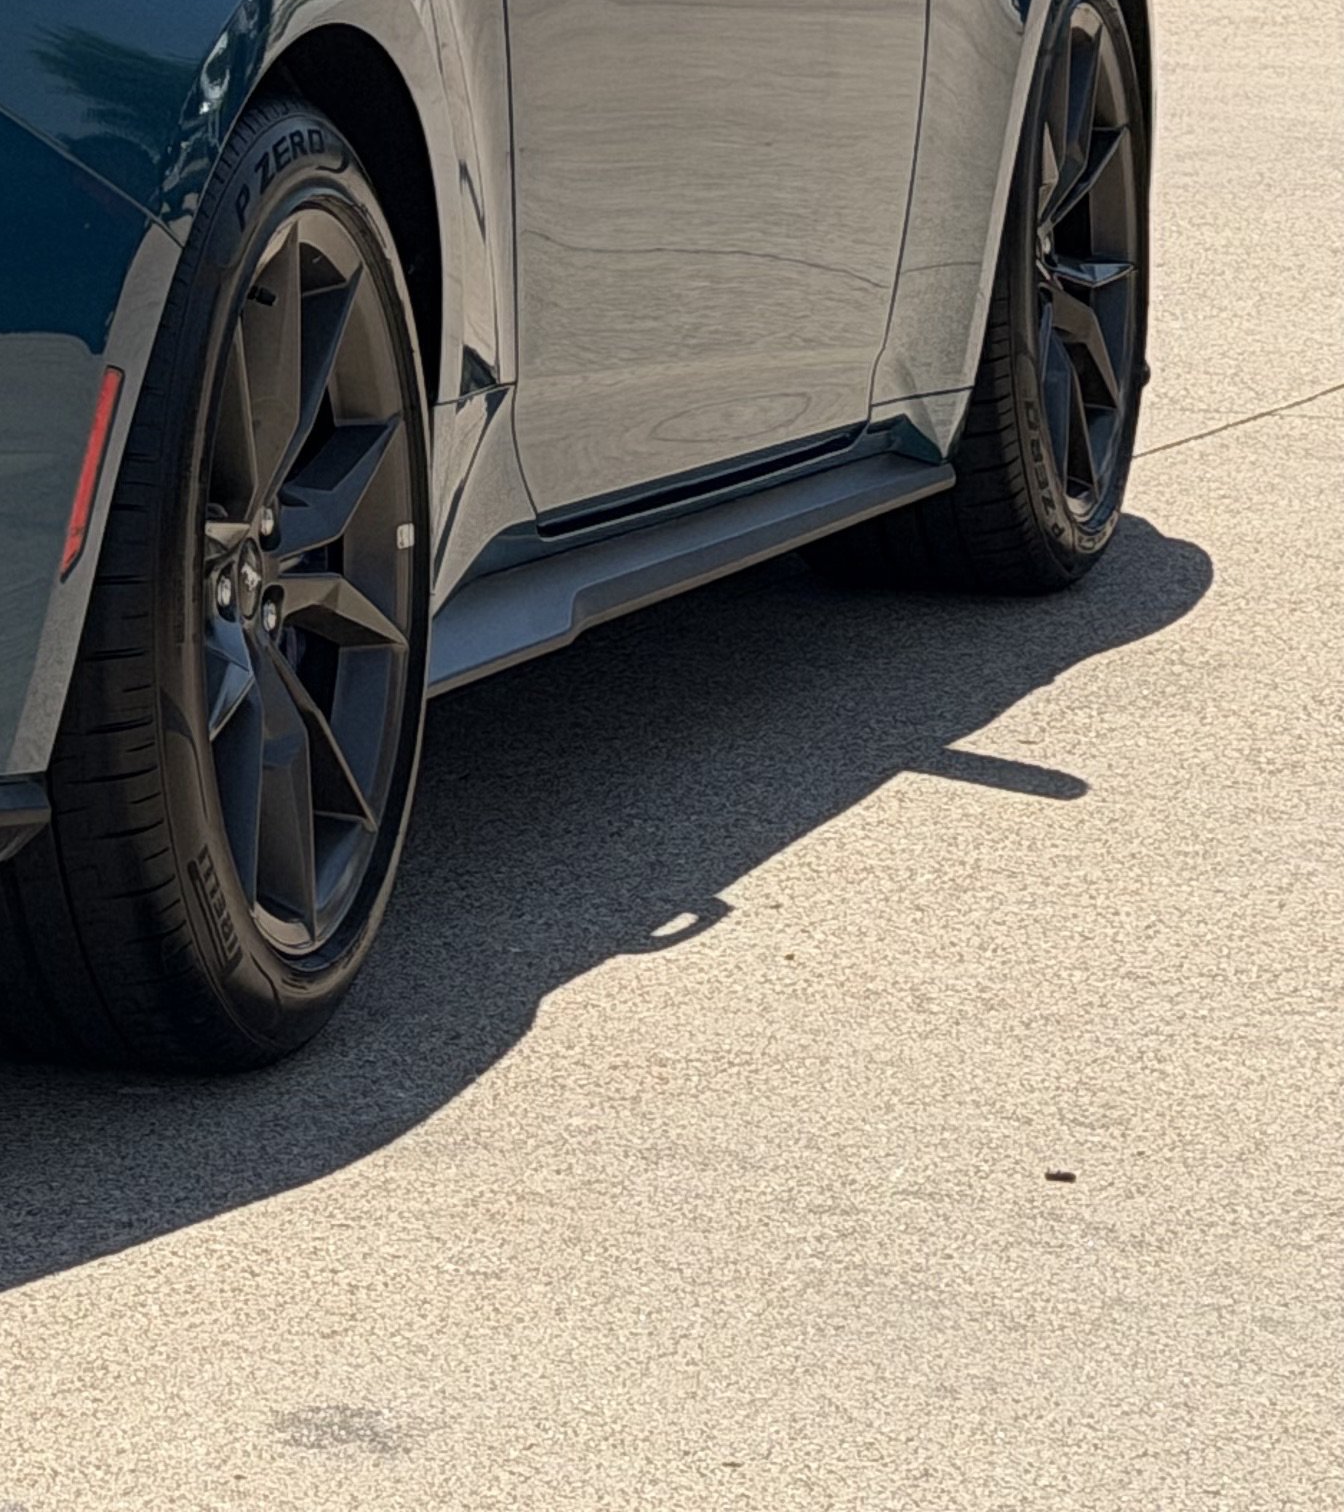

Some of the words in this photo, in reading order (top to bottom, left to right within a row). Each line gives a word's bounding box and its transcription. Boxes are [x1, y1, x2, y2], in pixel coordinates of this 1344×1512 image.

[235, 184, 250, 233] P
[254, 129, 325, 195] ZERO
[188, 843, 243, 977] PIRELLI
